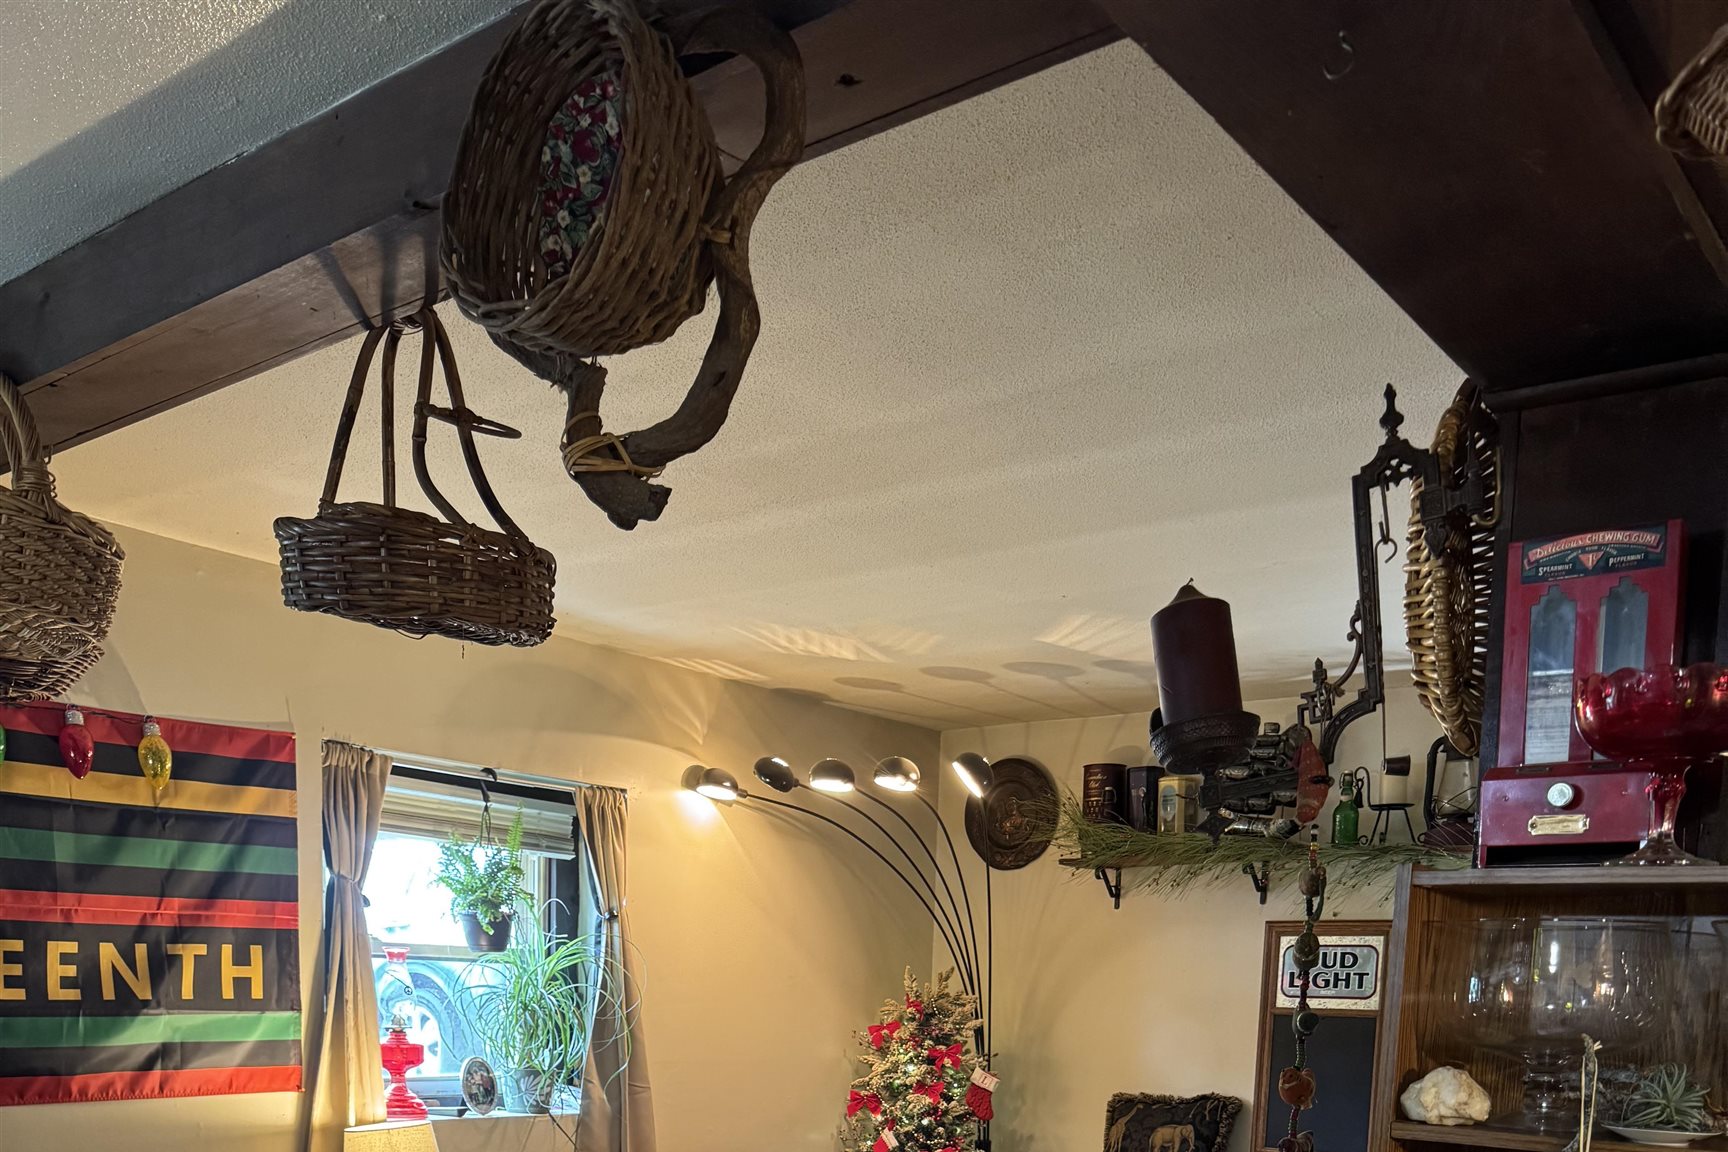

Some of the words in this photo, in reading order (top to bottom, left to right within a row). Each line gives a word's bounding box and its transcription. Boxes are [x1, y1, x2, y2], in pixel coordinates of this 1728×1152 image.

[1535, 540, 1584, 559] Delicious
[1585, 531, 1630, 545] CHEWING
[1631, 532, 1656, 545] GUM
[1608, 552, 1645, 567] PEPPERMINT
[1538, 563, 1573, 577] SPEARMINT
[1316, 951, 1359, 969] UD
[1288, 971, 1370, 990] LGHT
